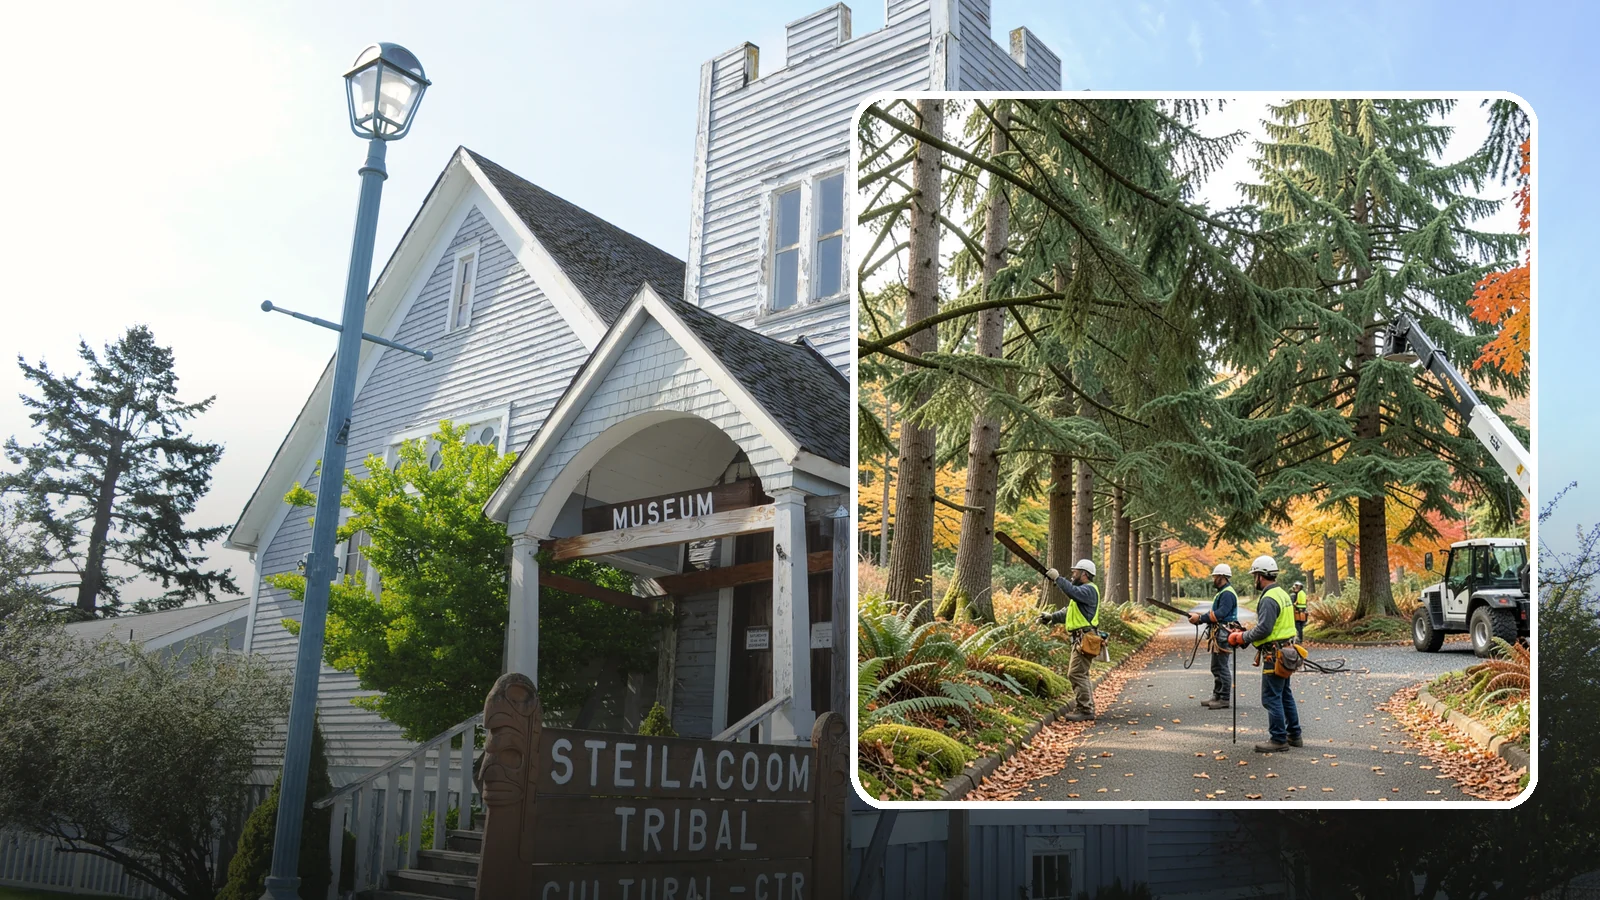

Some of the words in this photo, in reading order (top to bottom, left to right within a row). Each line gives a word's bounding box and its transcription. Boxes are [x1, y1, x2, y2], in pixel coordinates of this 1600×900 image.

[613, 491, 713, 530] MUSEUM
[550, 738, 809, 792] STEILACOOM
[615, 807, 757, 851] TRIBAL
